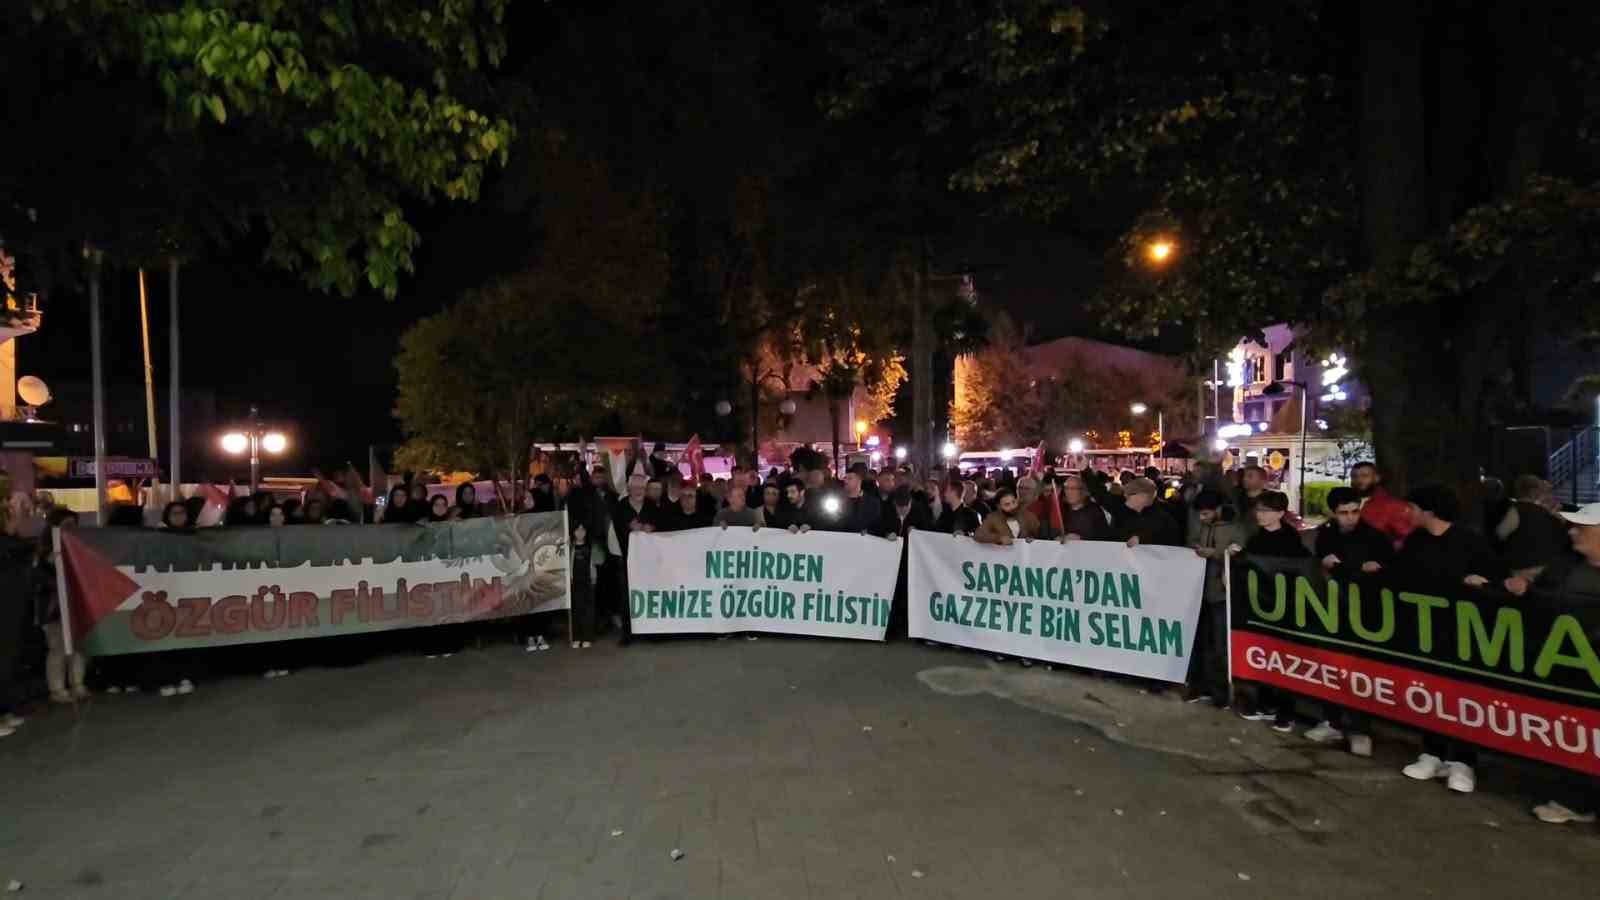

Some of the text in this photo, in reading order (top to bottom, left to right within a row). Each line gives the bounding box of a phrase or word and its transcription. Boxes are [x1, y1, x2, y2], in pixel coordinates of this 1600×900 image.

[705, 546, 824, 583] NEHİRDEN
[961, 560, 1142, 610] SAPANCA'DAN
[131, 572, 504, 641] ÖZGÜR FİLİSTİN
[630, 585, 713, 619] DENİZE
[720, 584, 796, 620] ÖZGÜR
[929, 592, 1184, 657] GAZZEYE BİN SELAM
[1247, 569, 1600, 688] UNUTMA
[1246, 645, 1397, 706] GAZZE'DE
